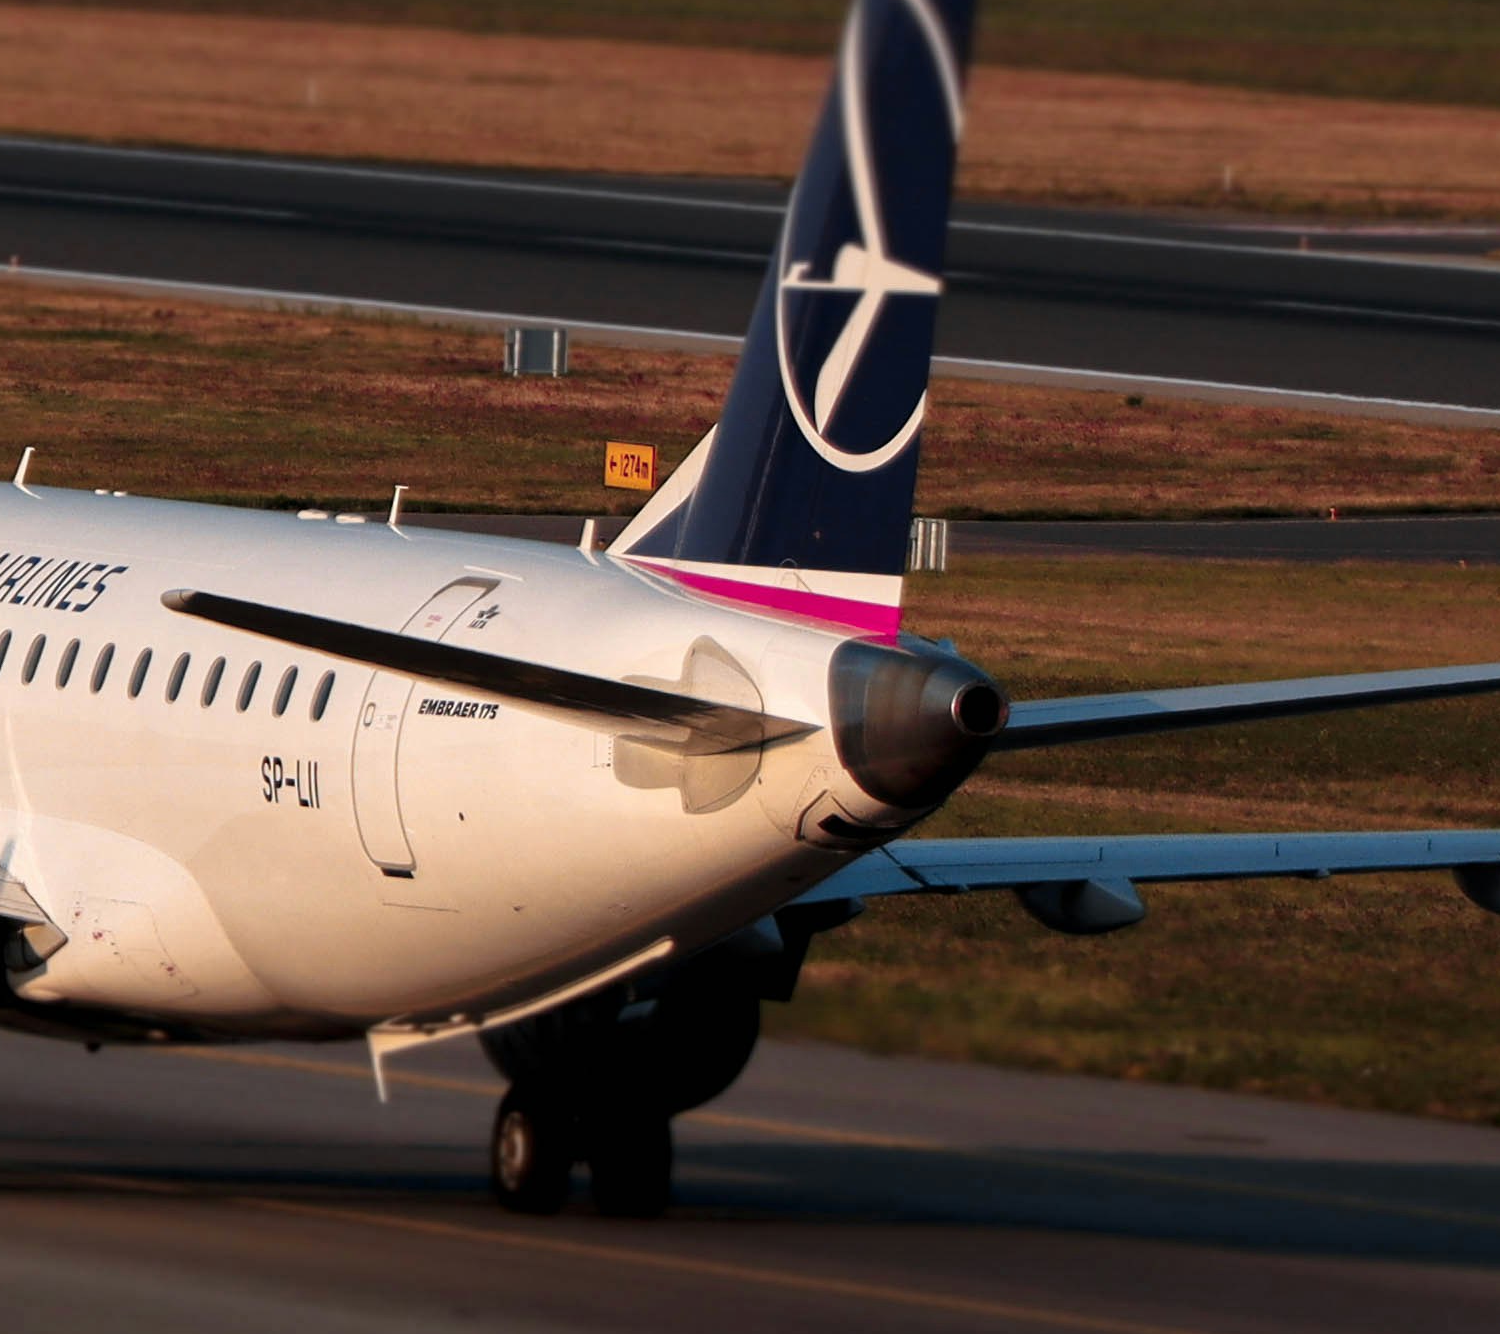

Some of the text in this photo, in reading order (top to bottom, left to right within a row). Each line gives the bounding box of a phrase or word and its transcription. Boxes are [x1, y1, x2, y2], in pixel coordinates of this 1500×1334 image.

[620, 453, 649, 479] 1274m
[417, 698, 499, 720] EMBRAER 175
[261, 755, 320, 809] SP-LII
